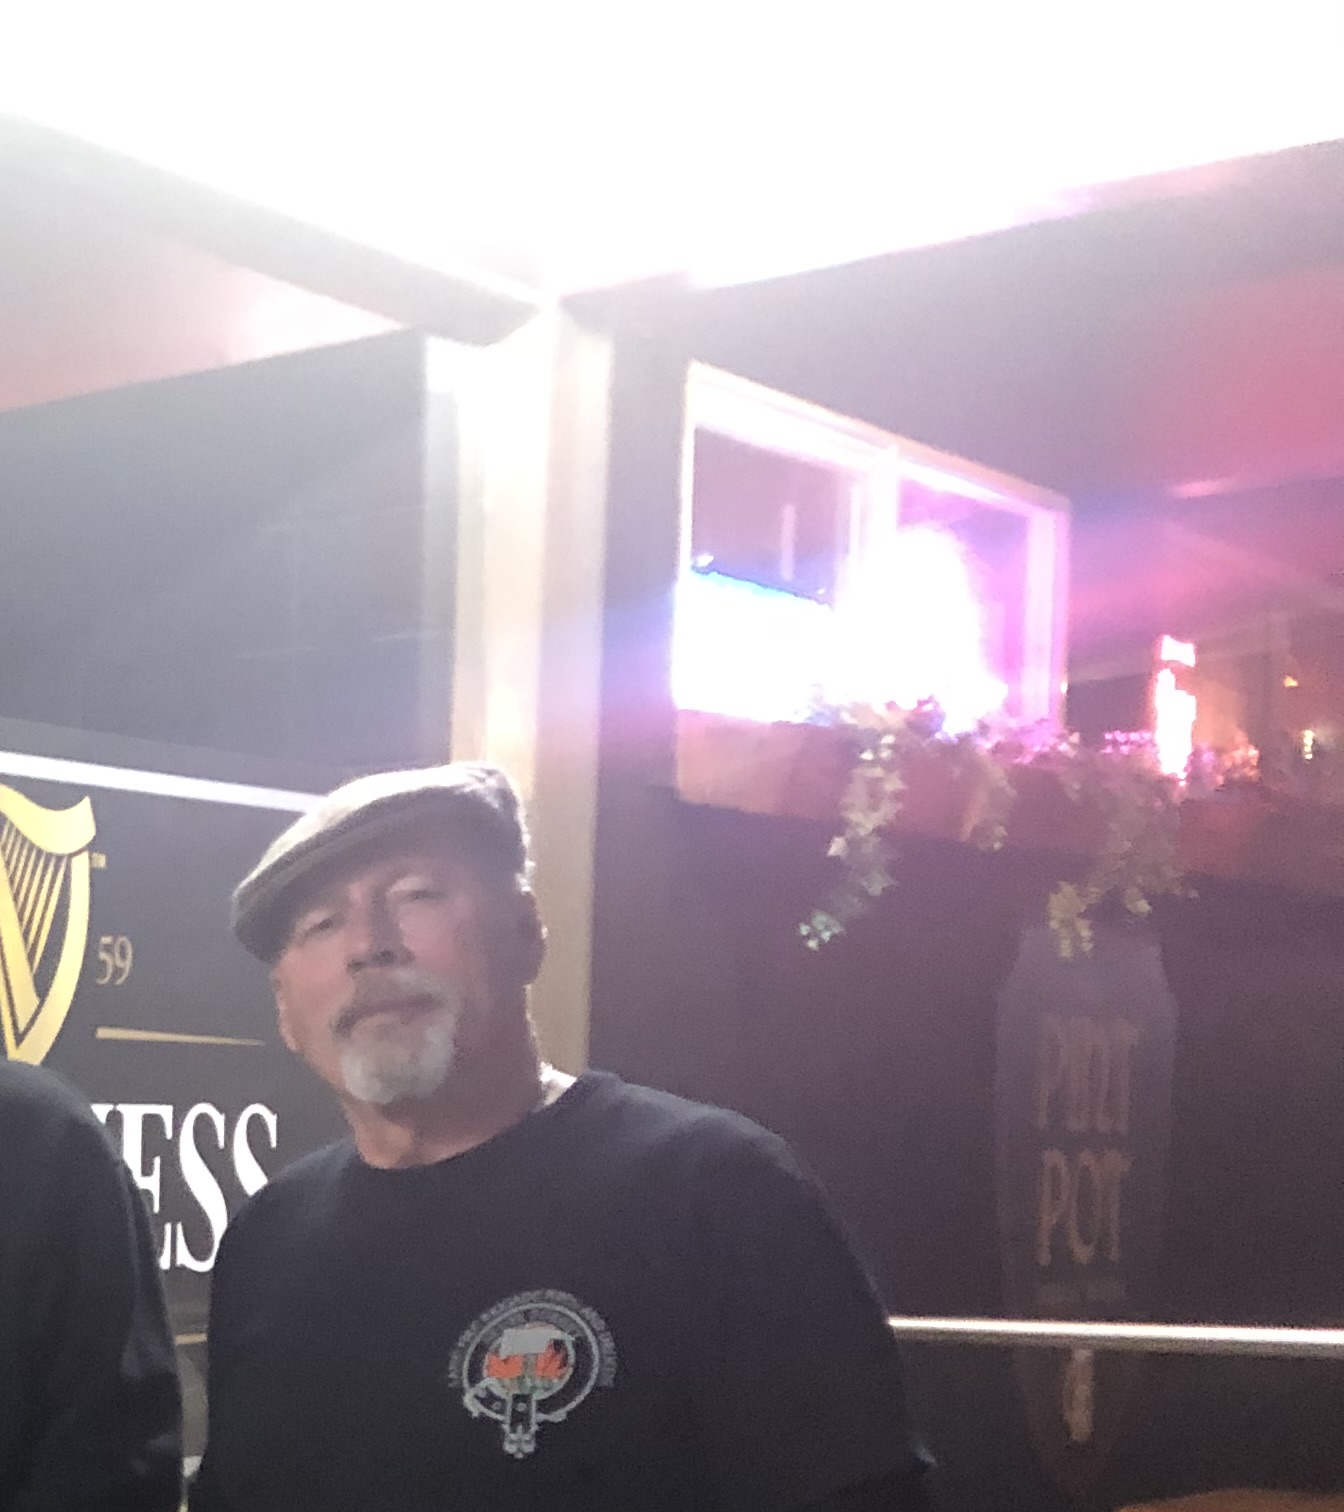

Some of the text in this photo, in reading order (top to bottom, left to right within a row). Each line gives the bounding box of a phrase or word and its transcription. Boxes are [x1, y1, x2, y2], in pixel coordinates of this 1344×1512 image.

[96, 935, 134, 986] 59
[90, 1102, 278, 1273] ESS
[1034, 1147, 1134, 1266] POT
